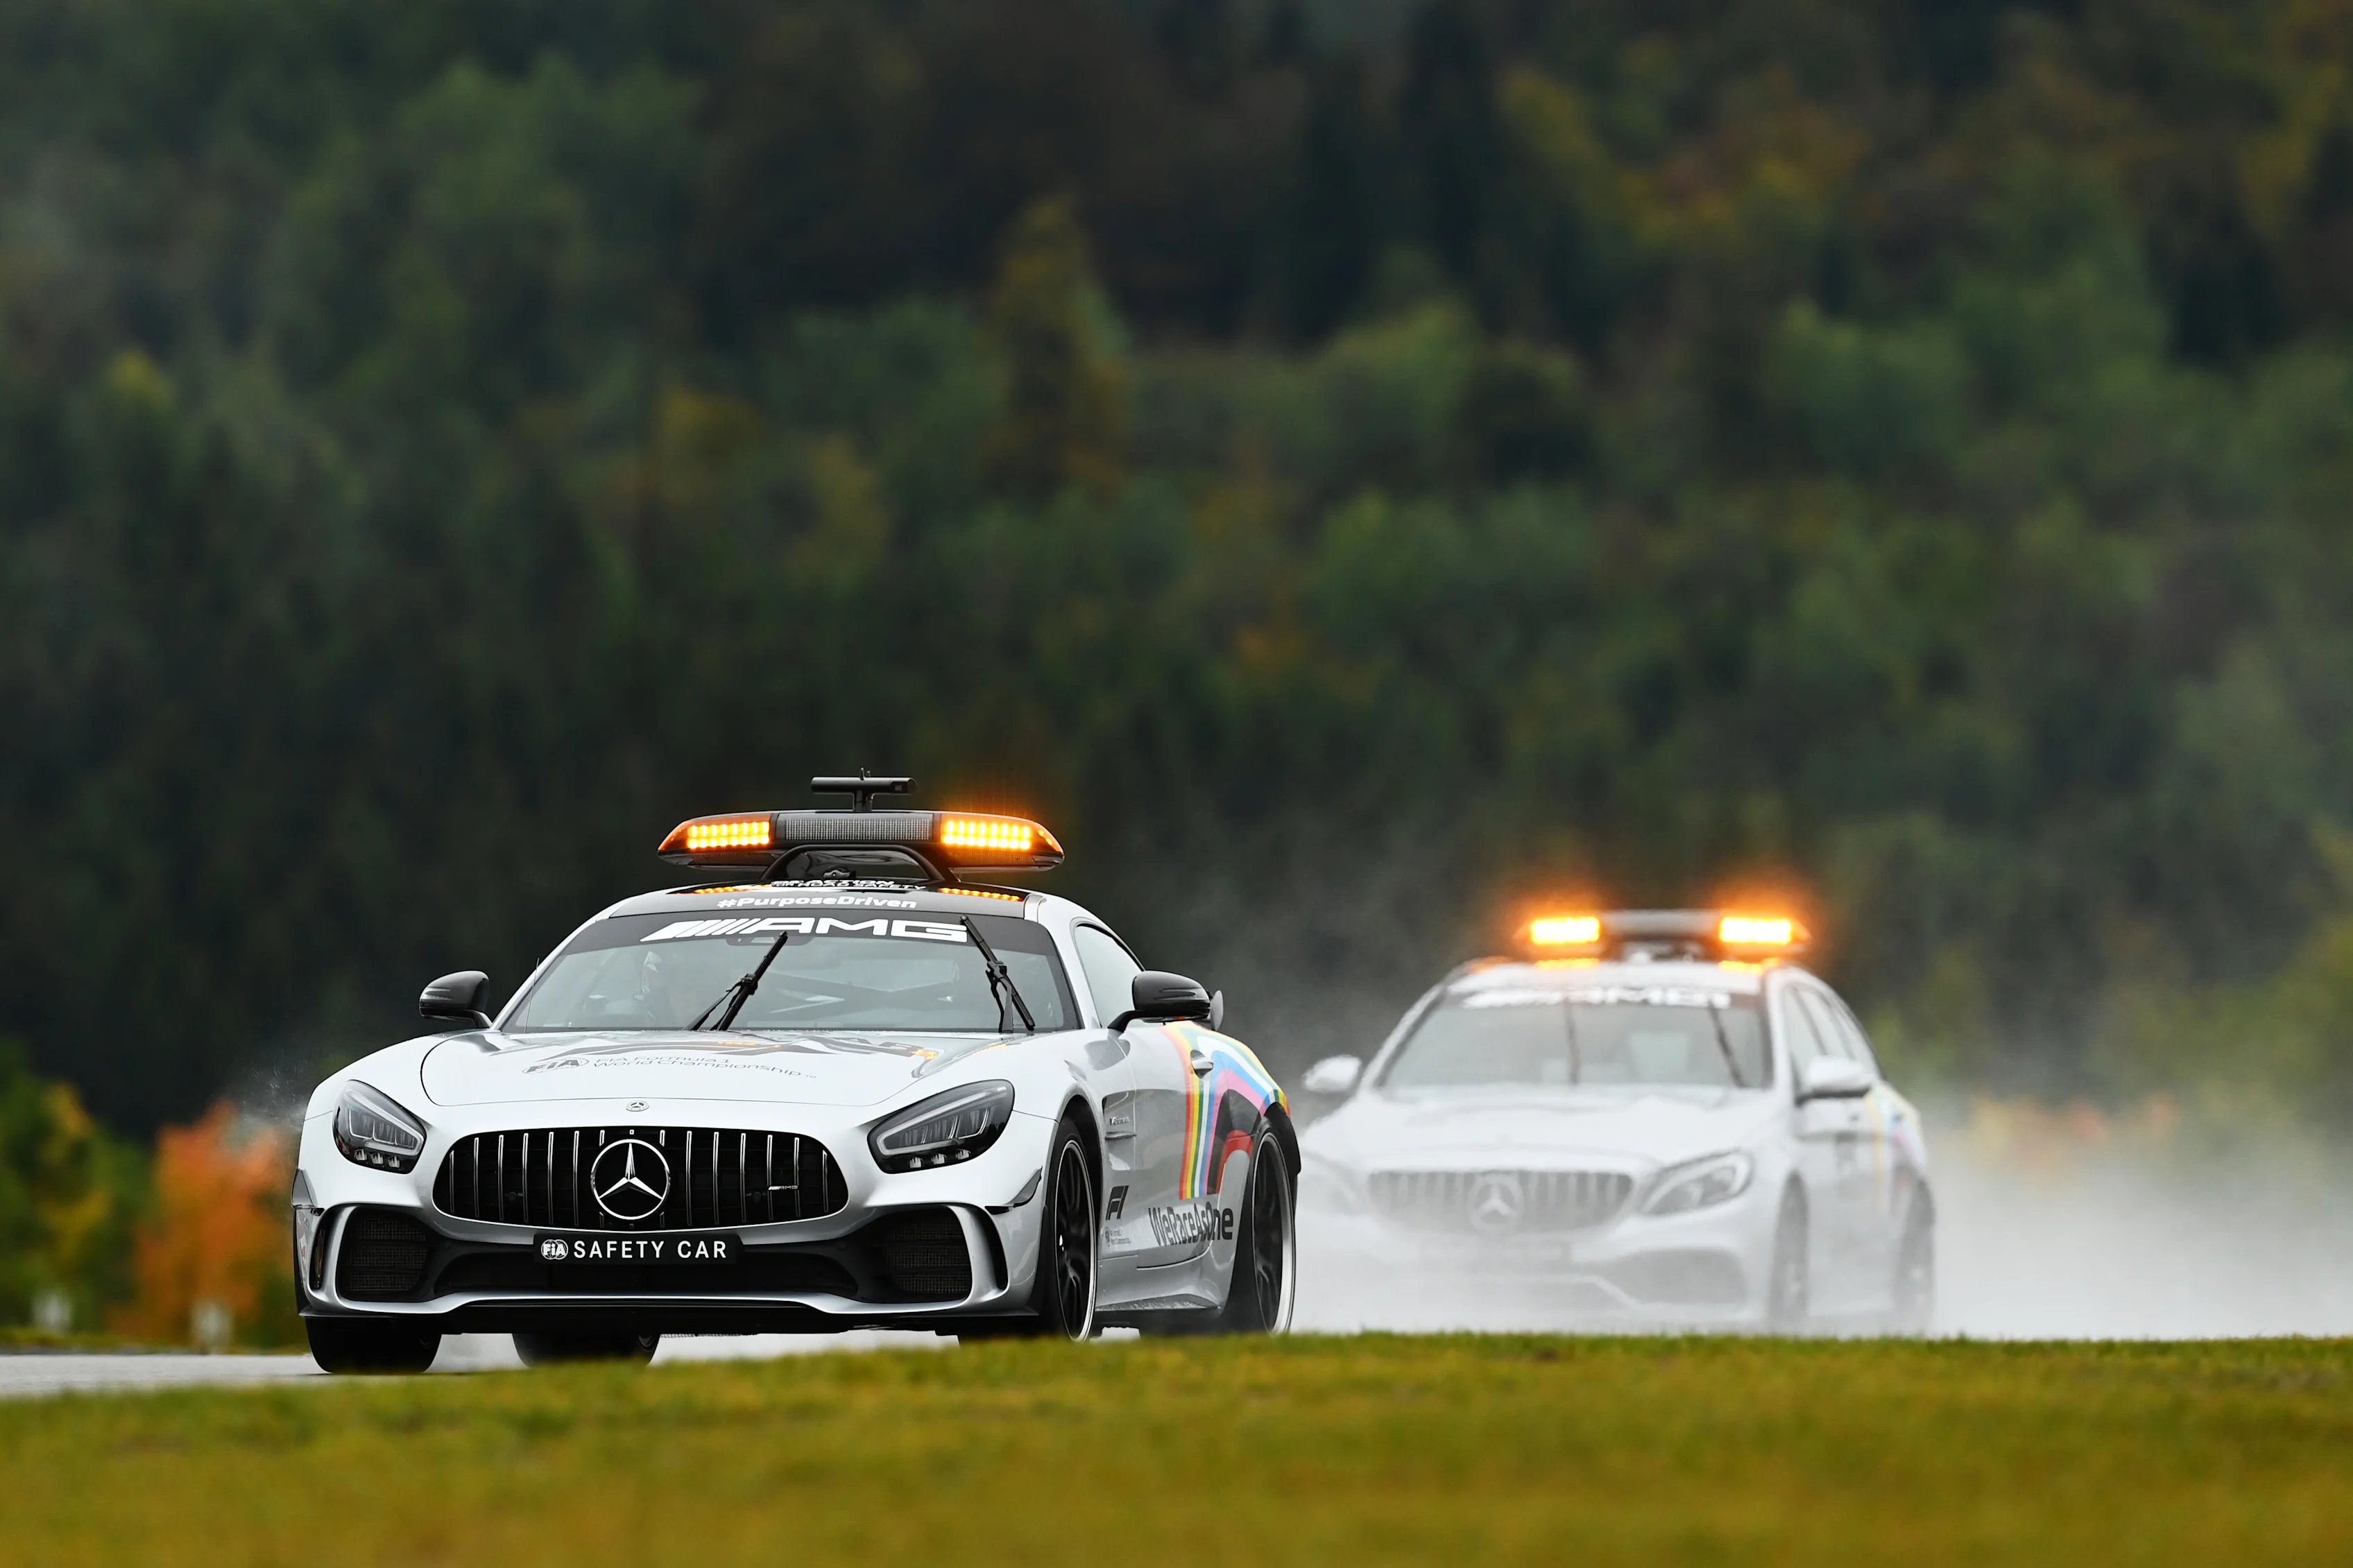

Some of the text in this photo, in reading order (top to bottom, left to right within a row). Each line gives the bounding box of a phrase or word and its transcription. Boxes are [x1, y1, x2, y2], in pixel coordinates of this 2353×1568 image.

[717, 896, 918, 908] #PurposeDriven
[744, 917, 968, 943] AMG
[658, 1060, 802, 1076] Championship
[1147, 1200, 1234, 1247] WeRaceAsOne
[573, 1240, 665, 1259] SAFETY
[677, 1240, 727, 1259] CAR
